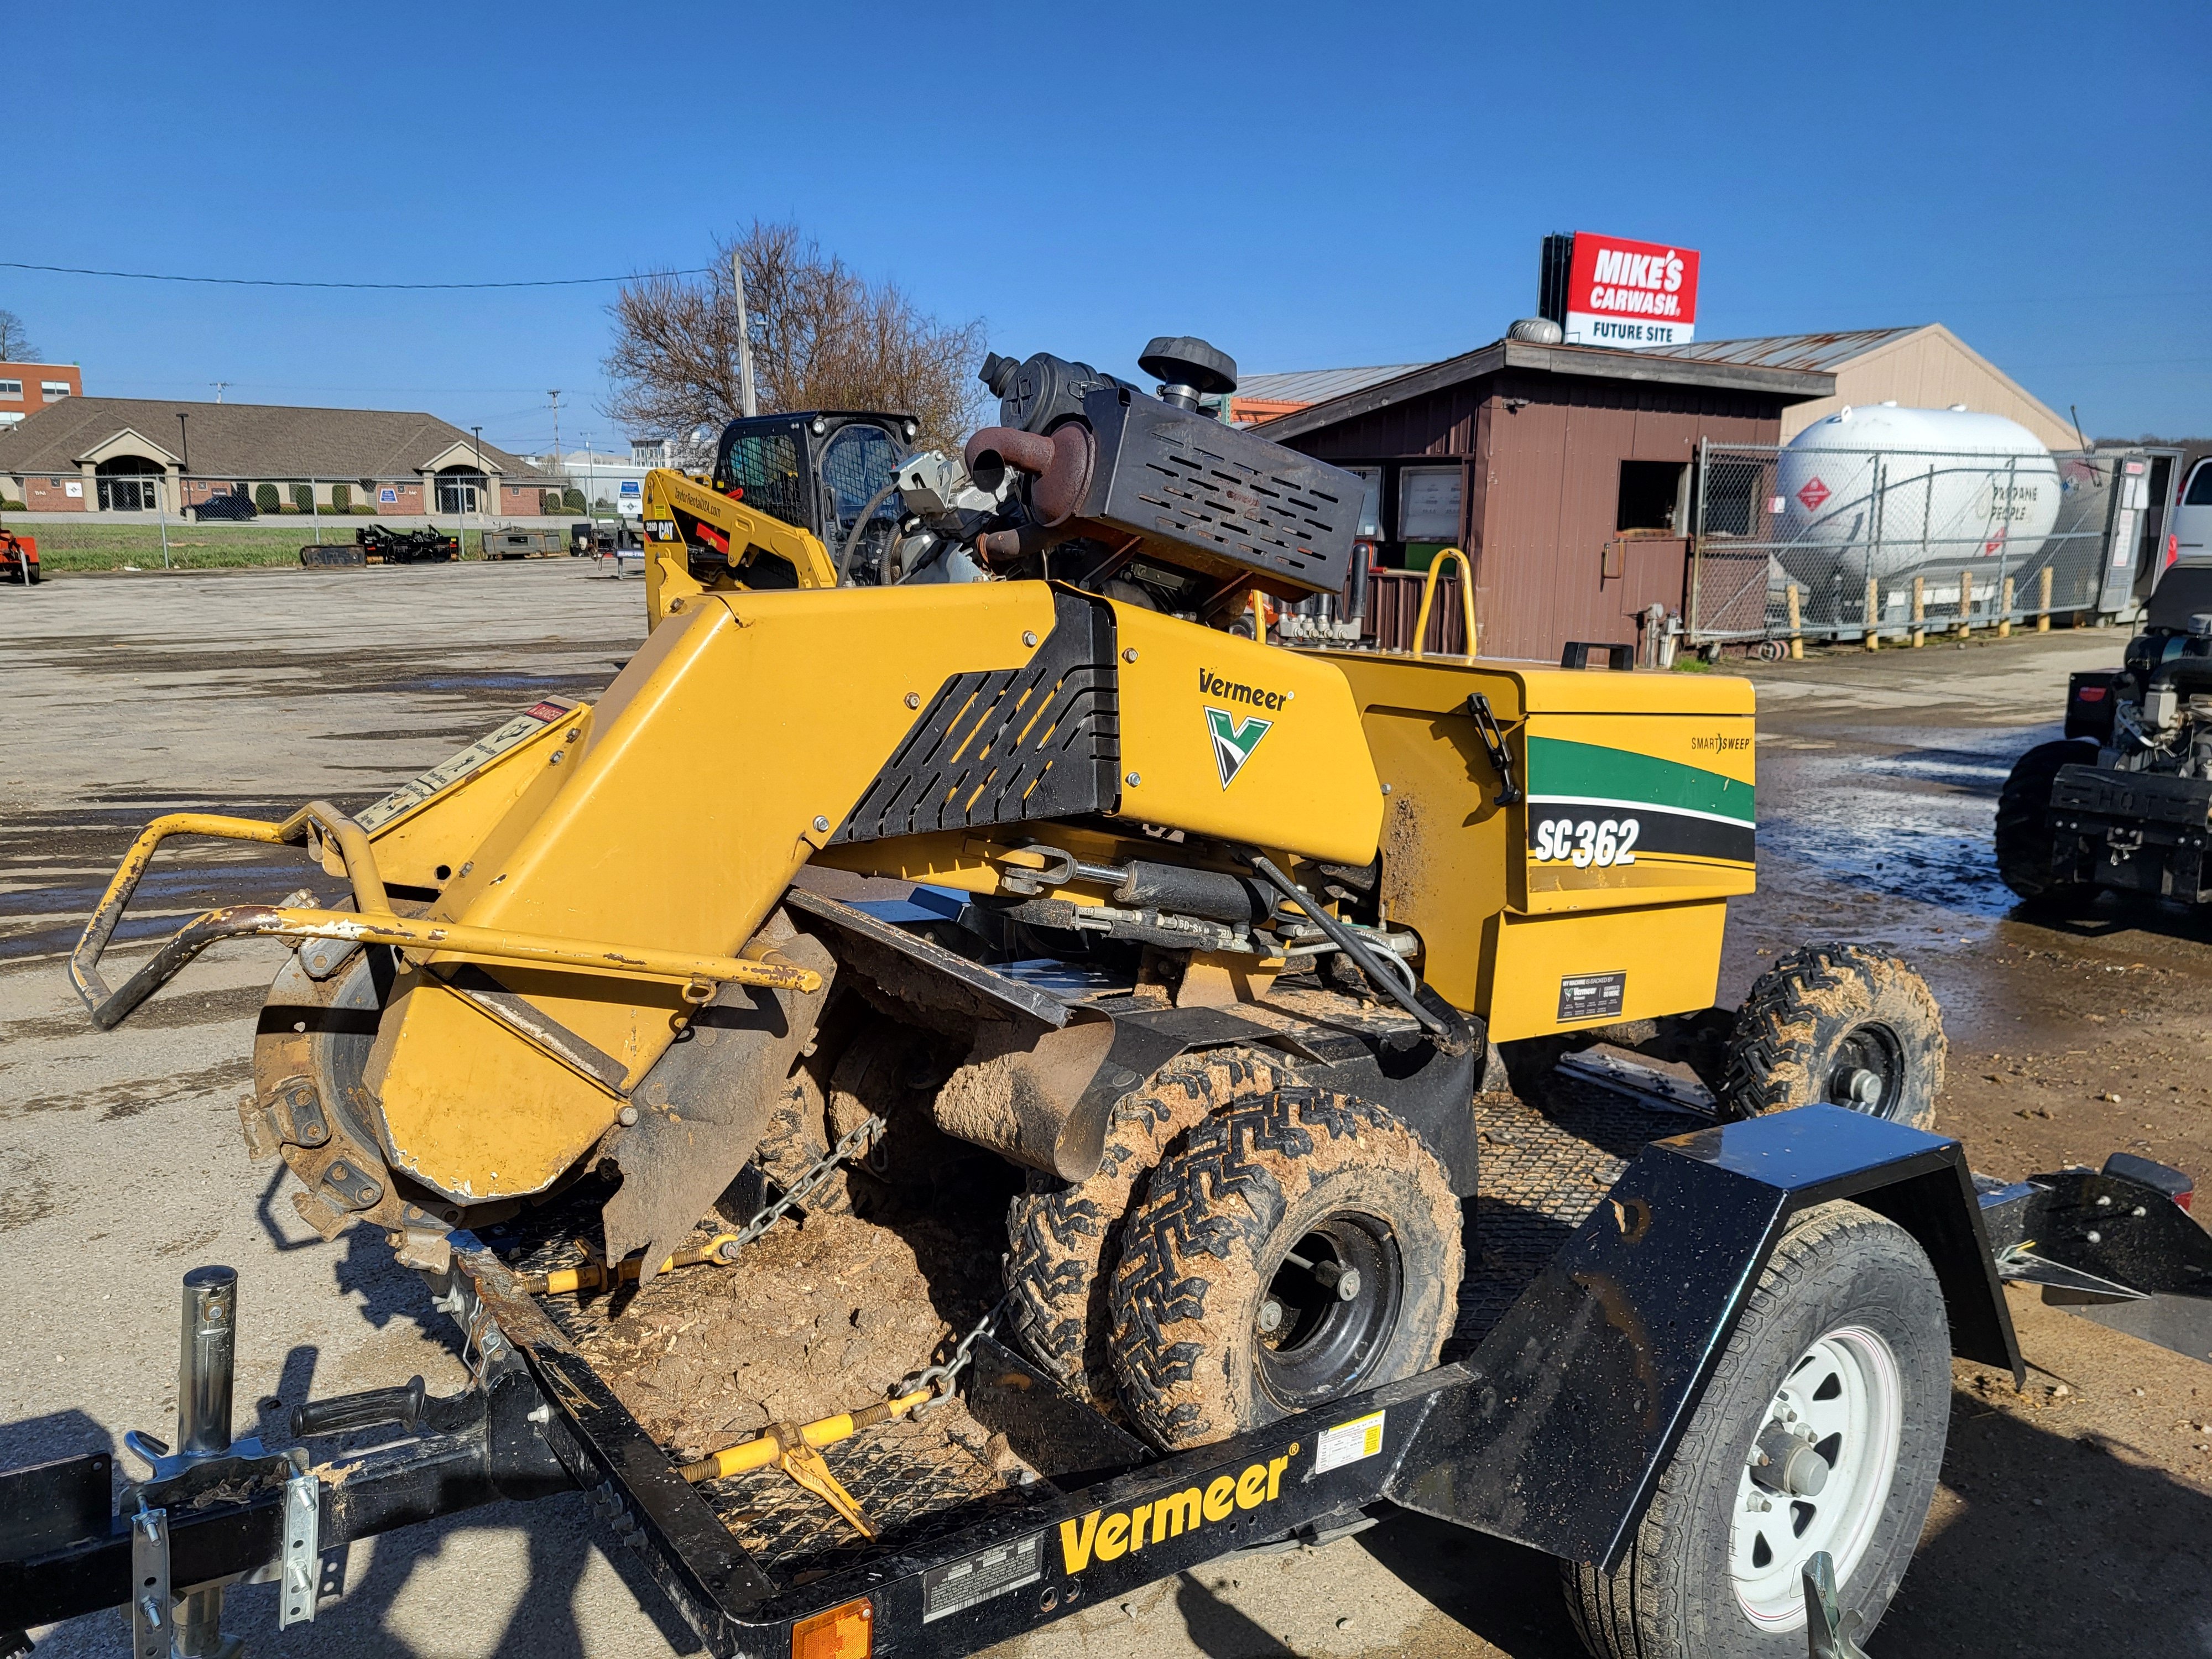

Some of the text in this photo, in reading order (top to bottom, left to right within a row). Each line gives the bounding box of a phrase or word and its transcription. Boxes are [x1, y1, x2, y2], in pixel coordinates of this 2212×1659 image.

[1593, 249, 1684, 293] MIKE'S
[1590, 285, 1679, 317] CARWASH
[1593, 321, 1673, 342] FUTURE SITE
[675, 486, 721, 518] TaylorRentalUSA.com
[646, 521, 674, 540] 226D CAT
[1199, 667, 1287, 712] Vermeer
[1536, 818, 1640, 868] SC362
[1060, 1455, 1288, 1575] Vermeer
